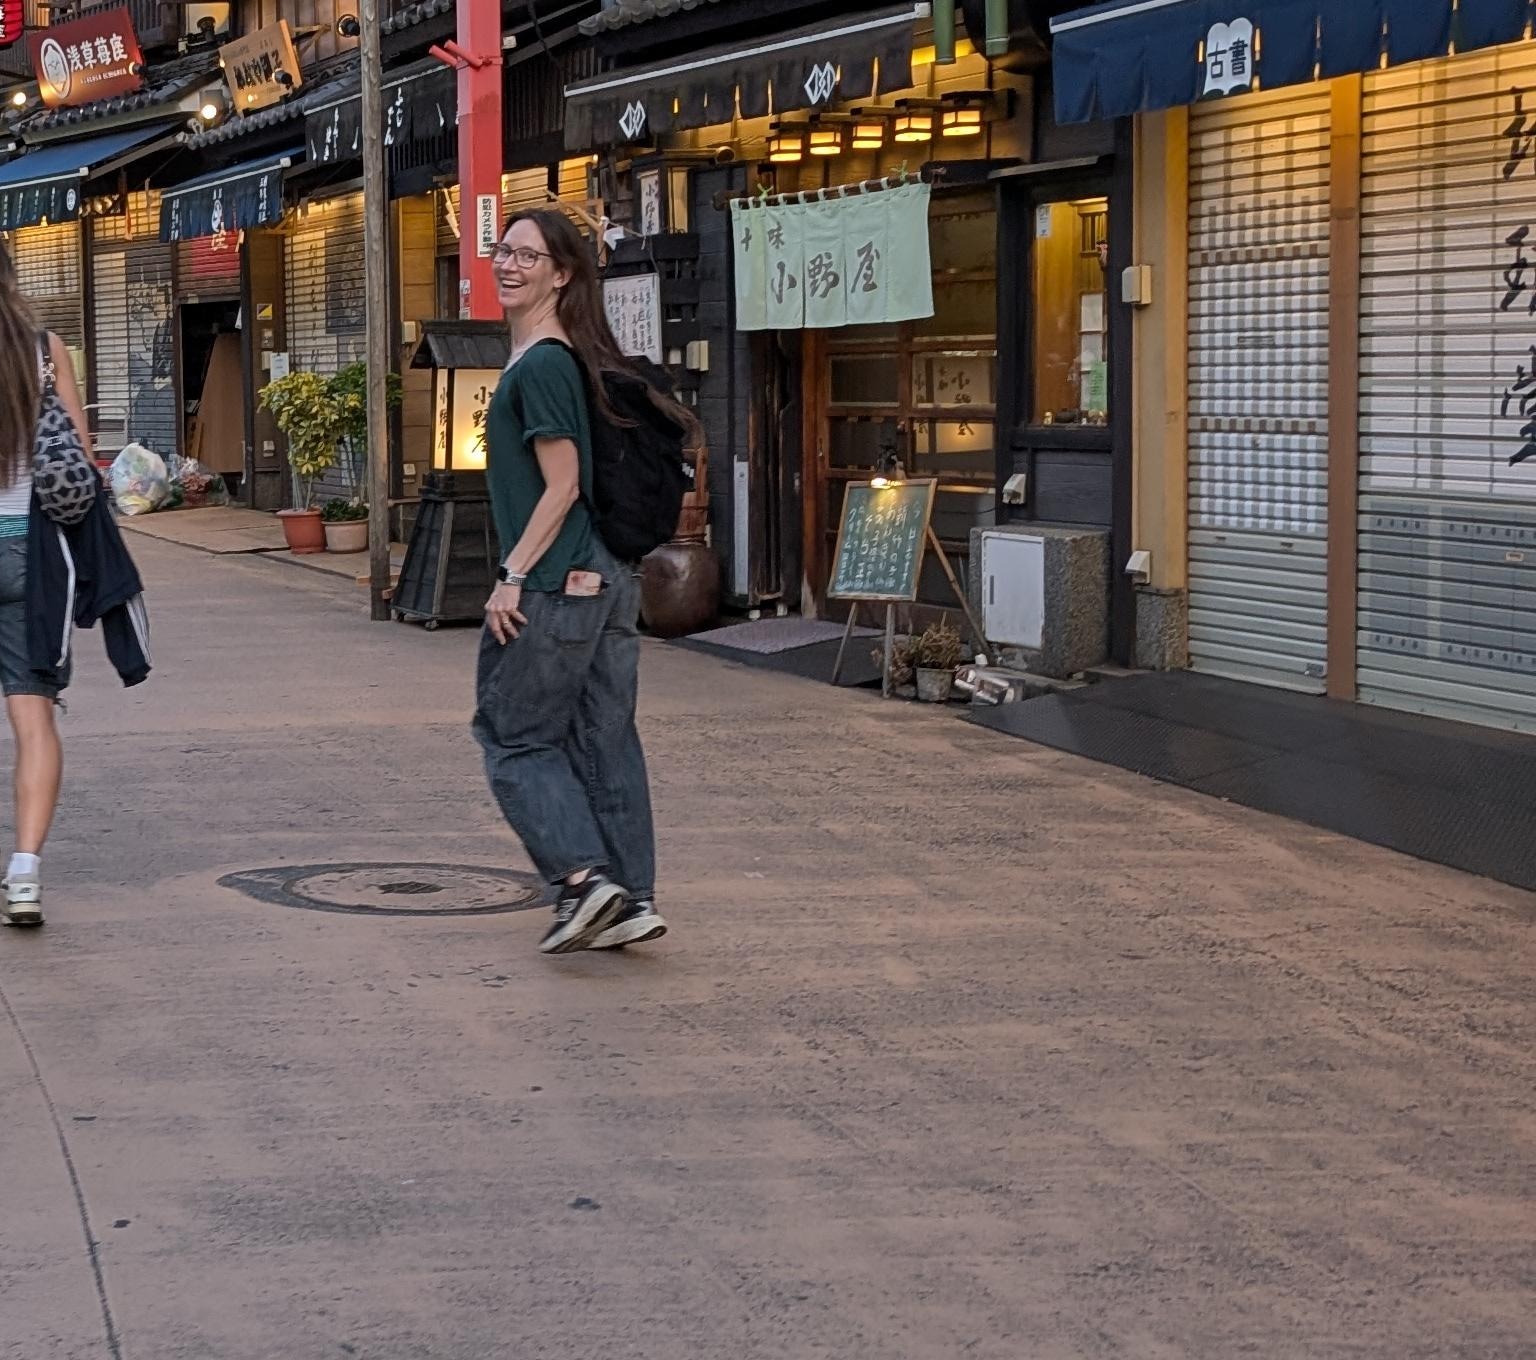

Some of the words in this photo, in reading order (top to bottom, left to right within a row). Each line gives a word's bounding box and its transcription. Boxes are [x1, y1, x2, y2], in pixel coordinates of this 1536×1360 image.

[66, 32, 128, 73] 浅草苺座
[1207, 37, 1249, 79] 古書
[771, 241, 881, 305] 小野屋
